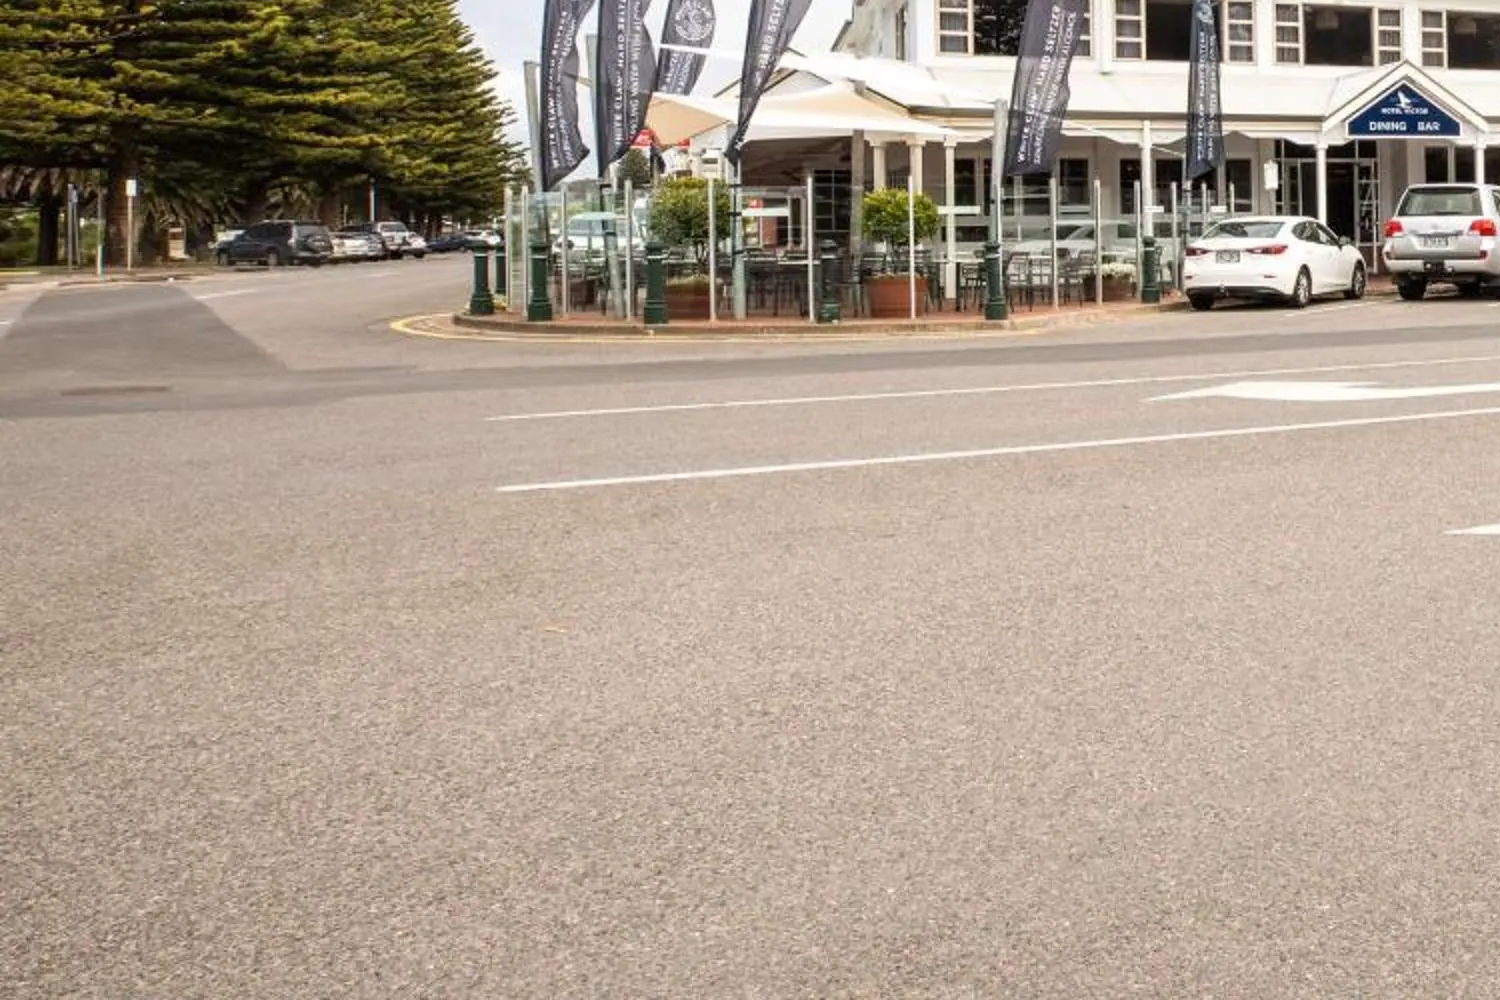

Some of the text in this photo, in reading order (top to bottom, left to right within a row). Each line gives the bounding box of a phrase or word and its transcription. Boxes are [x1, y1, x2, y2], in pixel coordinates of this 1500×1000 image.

[616, 34, 626, 68] HARD
[760, 36, 774, 69] HARD
[614, 77, 625, 110] CLAW
[548, 95, 557, 129] CLAW
[1369, 121, 1441, 131] DINING BAR
